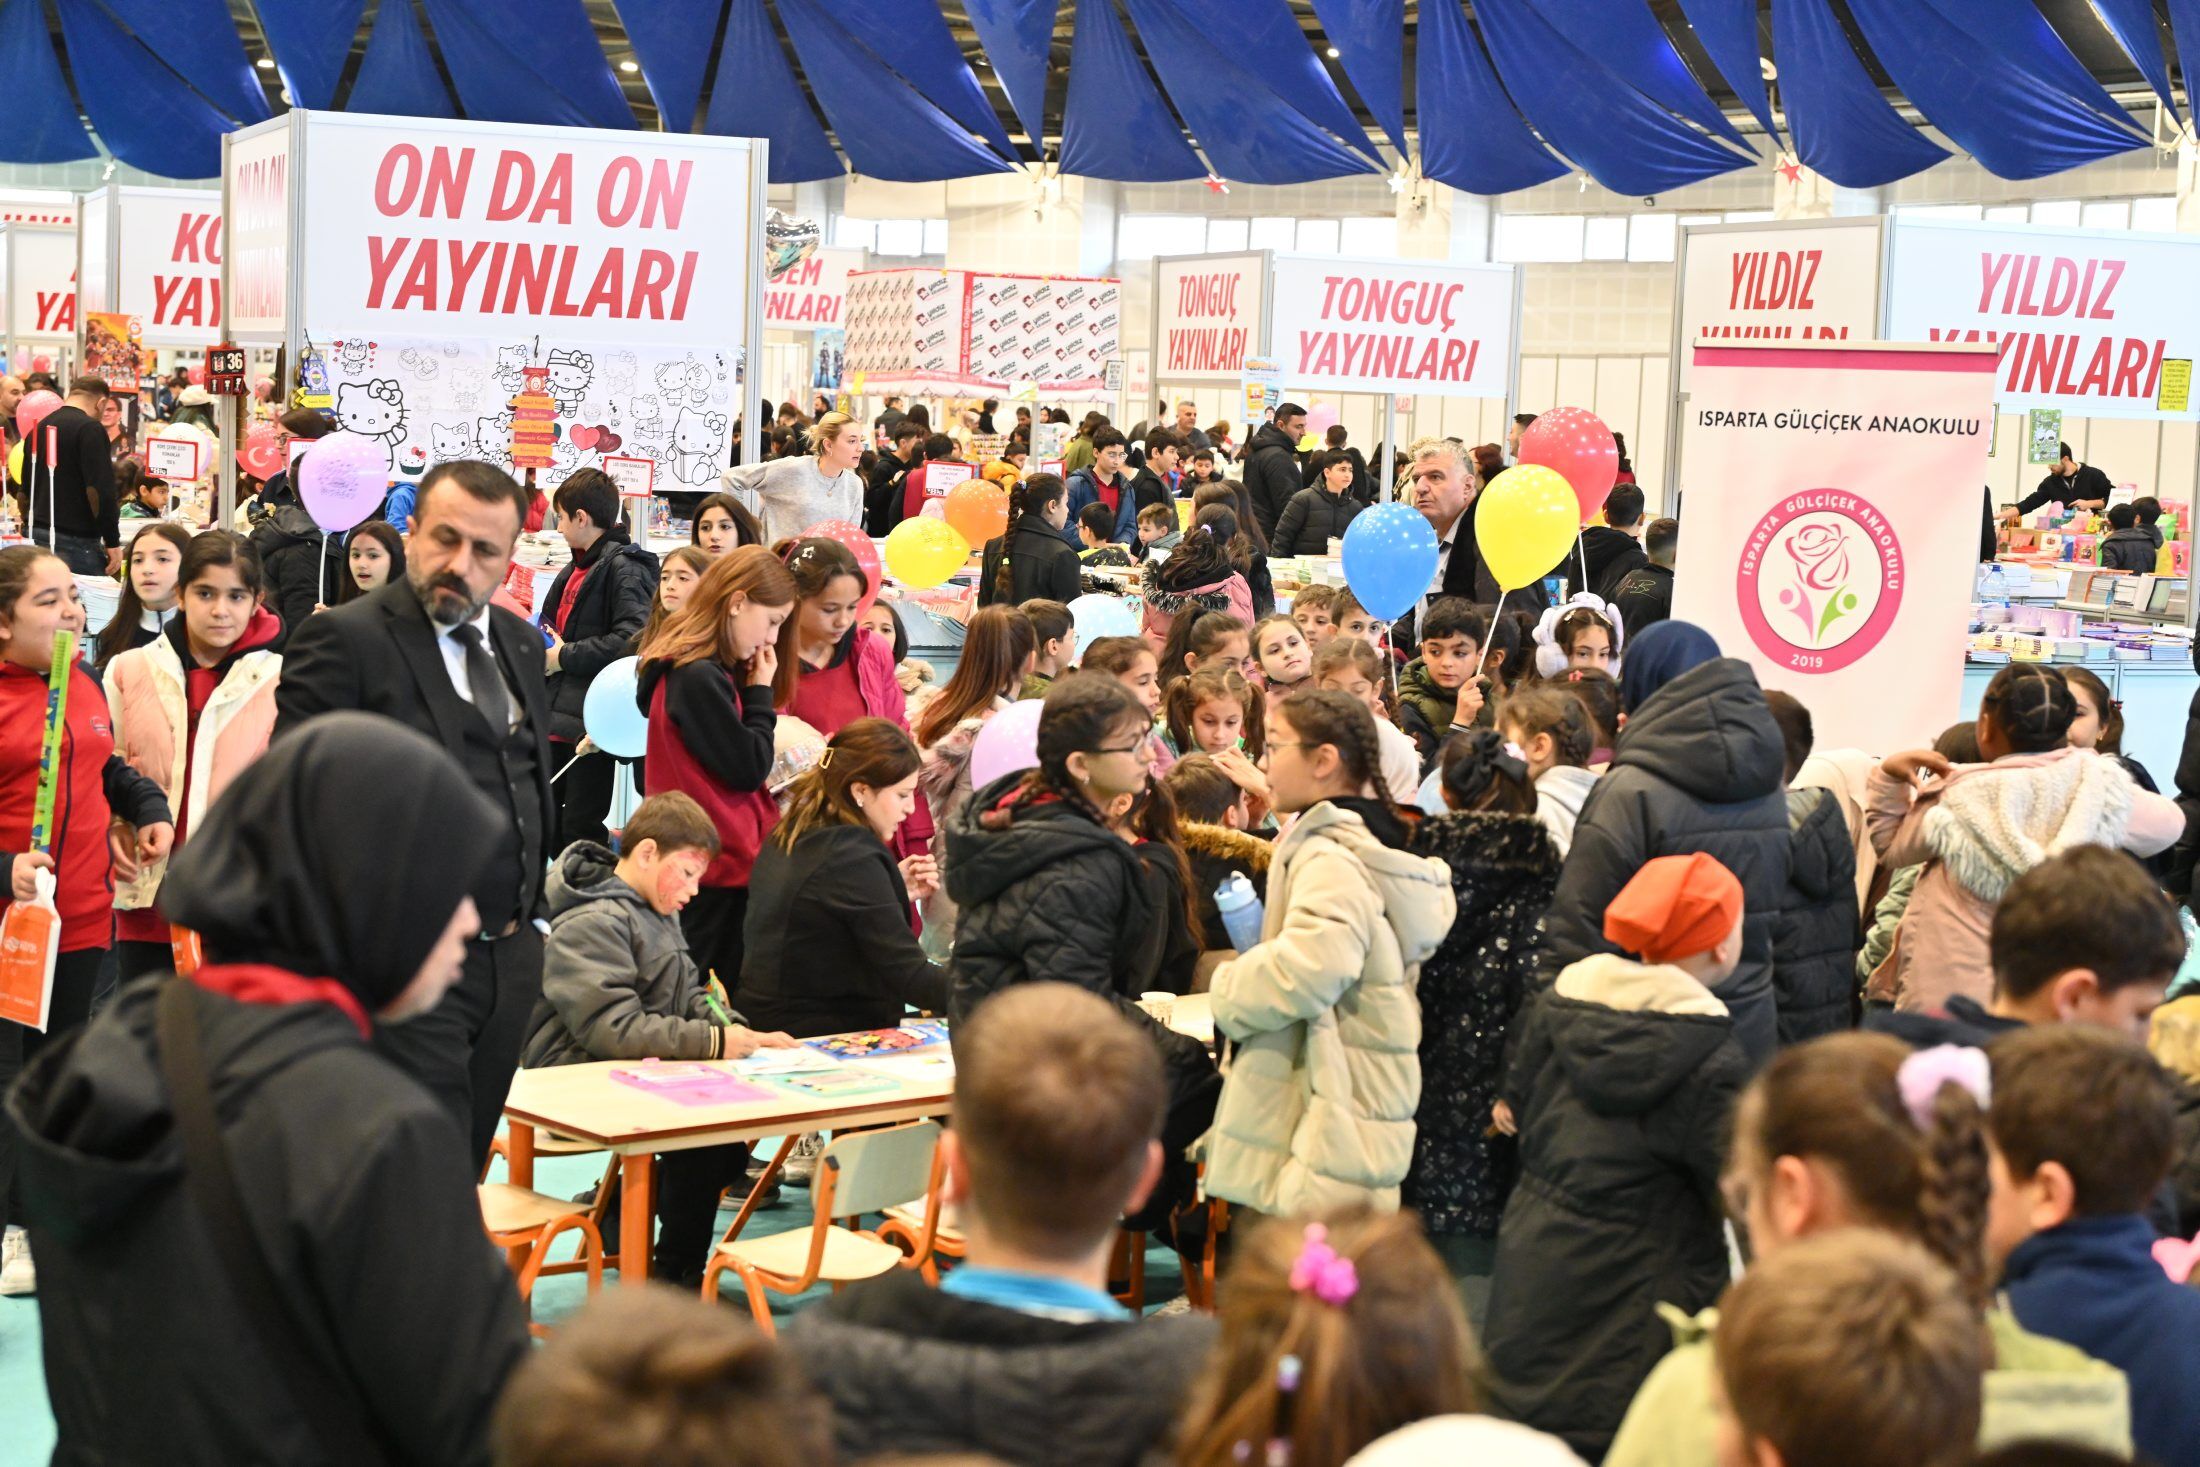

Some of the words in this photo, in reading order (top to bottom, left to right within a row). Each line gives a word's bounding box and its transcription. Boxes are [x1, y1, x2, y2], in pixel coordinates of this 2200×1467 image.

[375, 143, 475, 219] ON
[486, 150, 573, 224] DA
[597, 156, 692, 230] ON
[366, 236, 698, 322] YAYINLARI
[1177, 273, 1241, 322] TONGUÇ
[1321, 276, 1464, 334] TONGUÇ
[1729, 249, 1823, 310] YILDIZ
[1979, 253, 2125, 320] YILDIZ
[227, 352, 243, 370] 36
[1167, 327, 1247, 372] YAYINLARI
[1299, 331, 1480, 382] YAYINLARI
[1699, 410, 1768, 428] ISPARTA
[1774, 408, 1863, 435] GÜLÇİÇEK
[1867, 415, 1980, 436] ANAOKULU
[1742, 515, 1780, 575] ISPARTA
[1785, 493, 1857, 513] GÜLÇİÇEK
[1859, 508, 1899, 590] ANAOKULU
[1791, 654, 1823, 668] 2019
